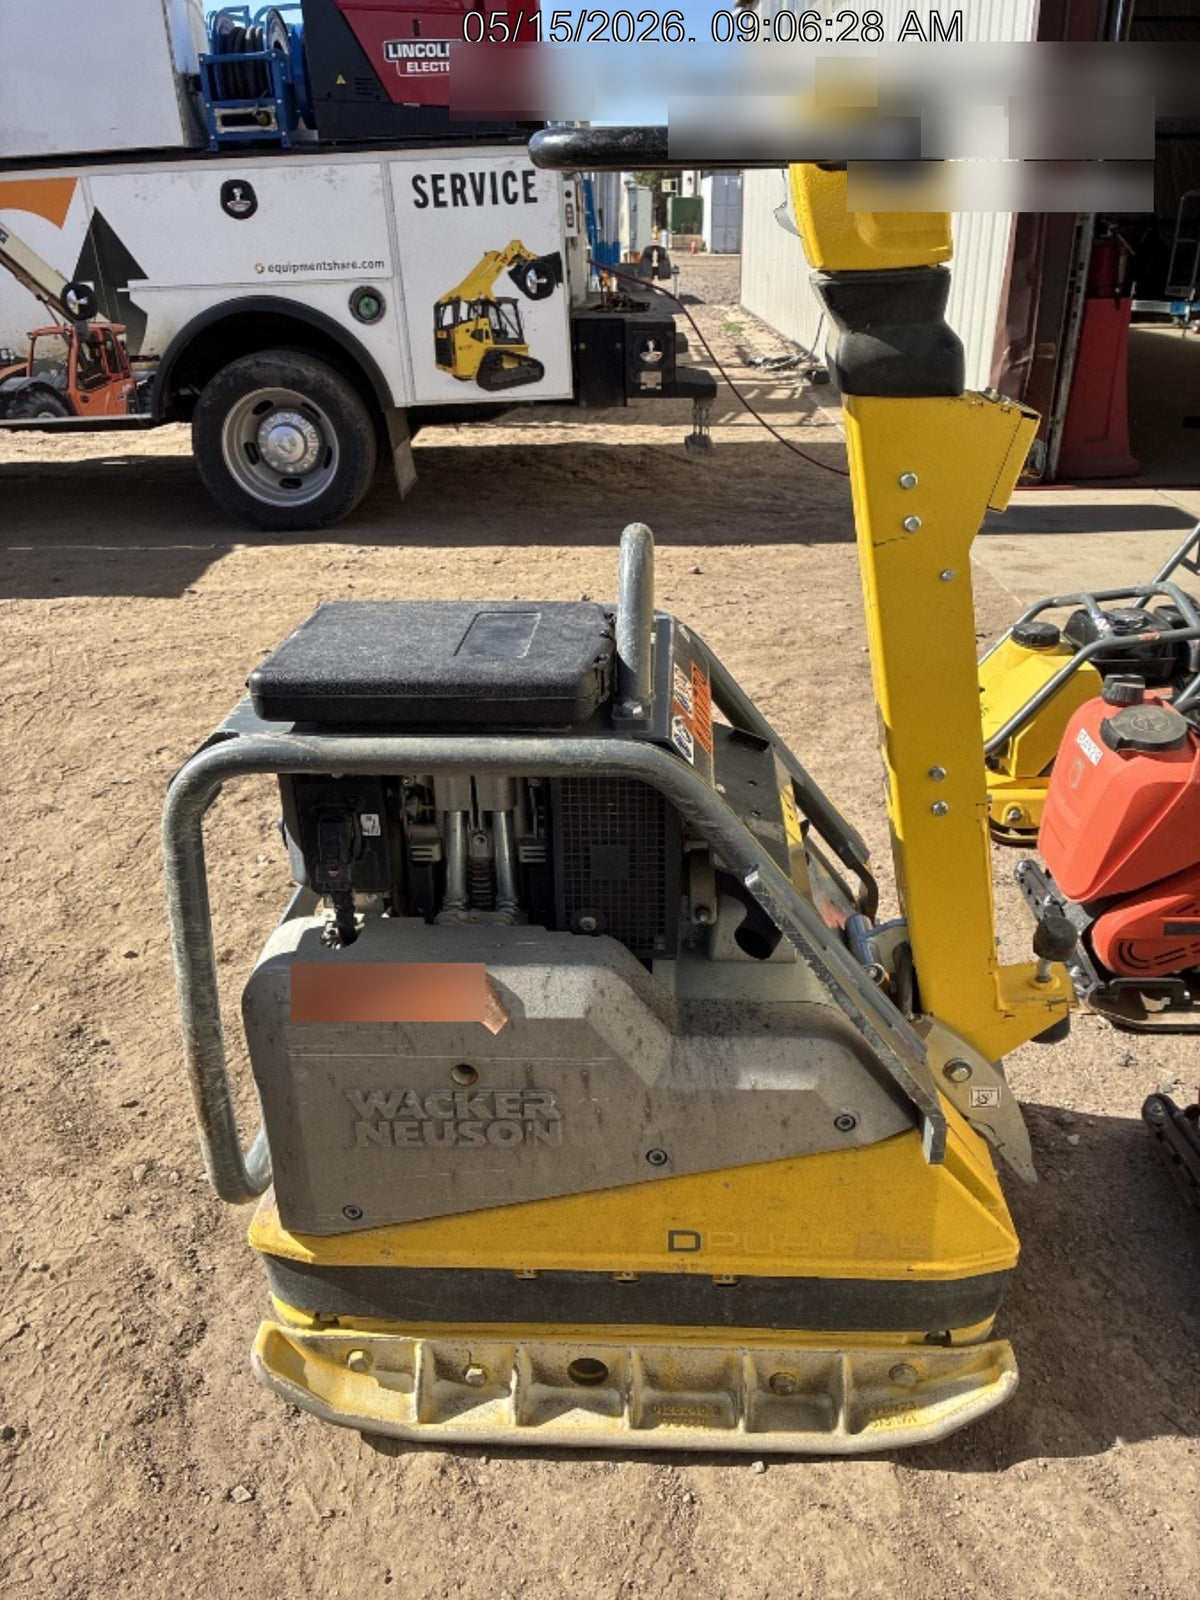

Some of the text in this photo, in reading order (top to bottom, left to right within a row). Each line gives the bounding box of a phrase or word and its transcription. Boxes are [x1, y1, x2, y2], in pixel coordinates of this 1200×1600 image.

[411, 169, 538, 209] SERVICE
[267, 259, 385, 274] equipmentshare.com
[346, 1089, 562, 1119] WACKER
[353, 1119, 562, 1147] NEUSON
